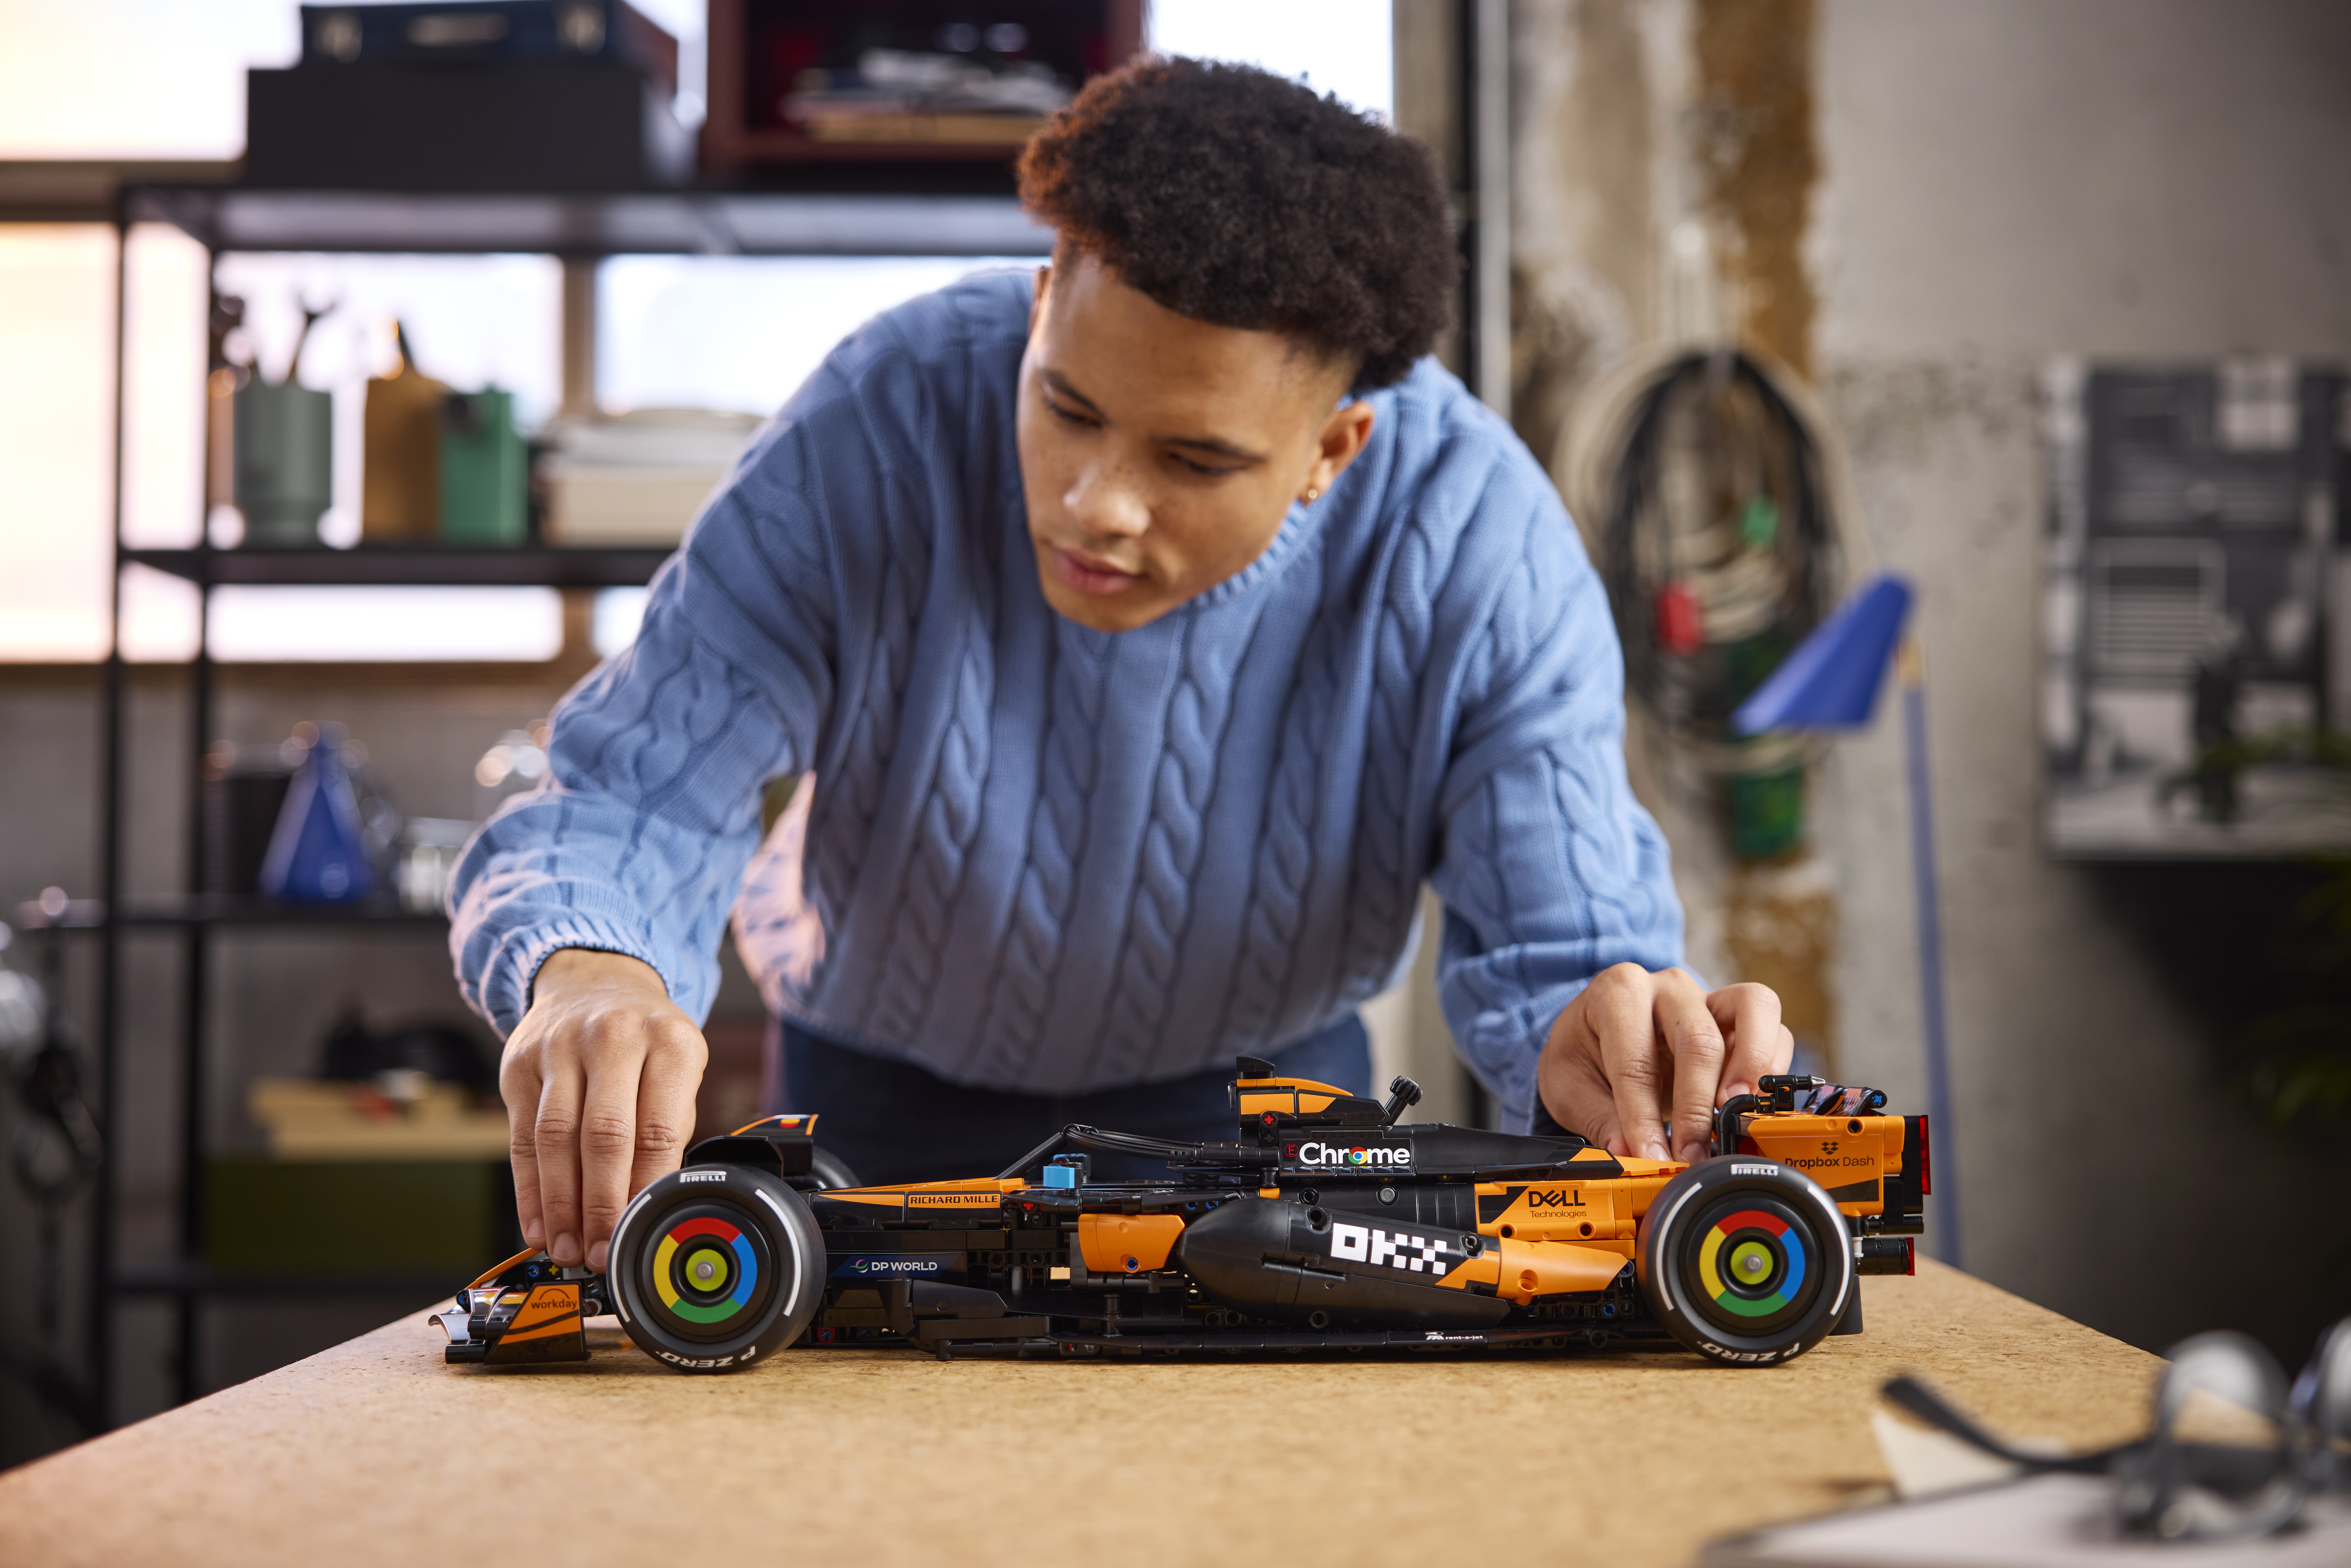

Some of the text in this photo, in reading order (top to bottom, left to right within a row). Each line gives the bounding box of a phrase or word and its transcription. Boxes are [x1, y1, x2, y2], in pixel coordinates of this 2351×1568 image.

[1299, 1142, 1411, 1165] Chrome
[1785, 1155, 1874, 1170] Dropbox Dash
[1731, 1164, 1779, 1176] PIRELLI
[680, 1171, 727, 1183] PIRELLI
[1528, 1190, 1586, 1208] DELL
[1529, 1210, 1587, 1219] Technologies
[872, 1262, 938, 1271] DP WORLD
[531, 1298, 577, 1309] workday
[740, 1345, 756, 1361] P
[1783, 1342, 1800, 1357] P
